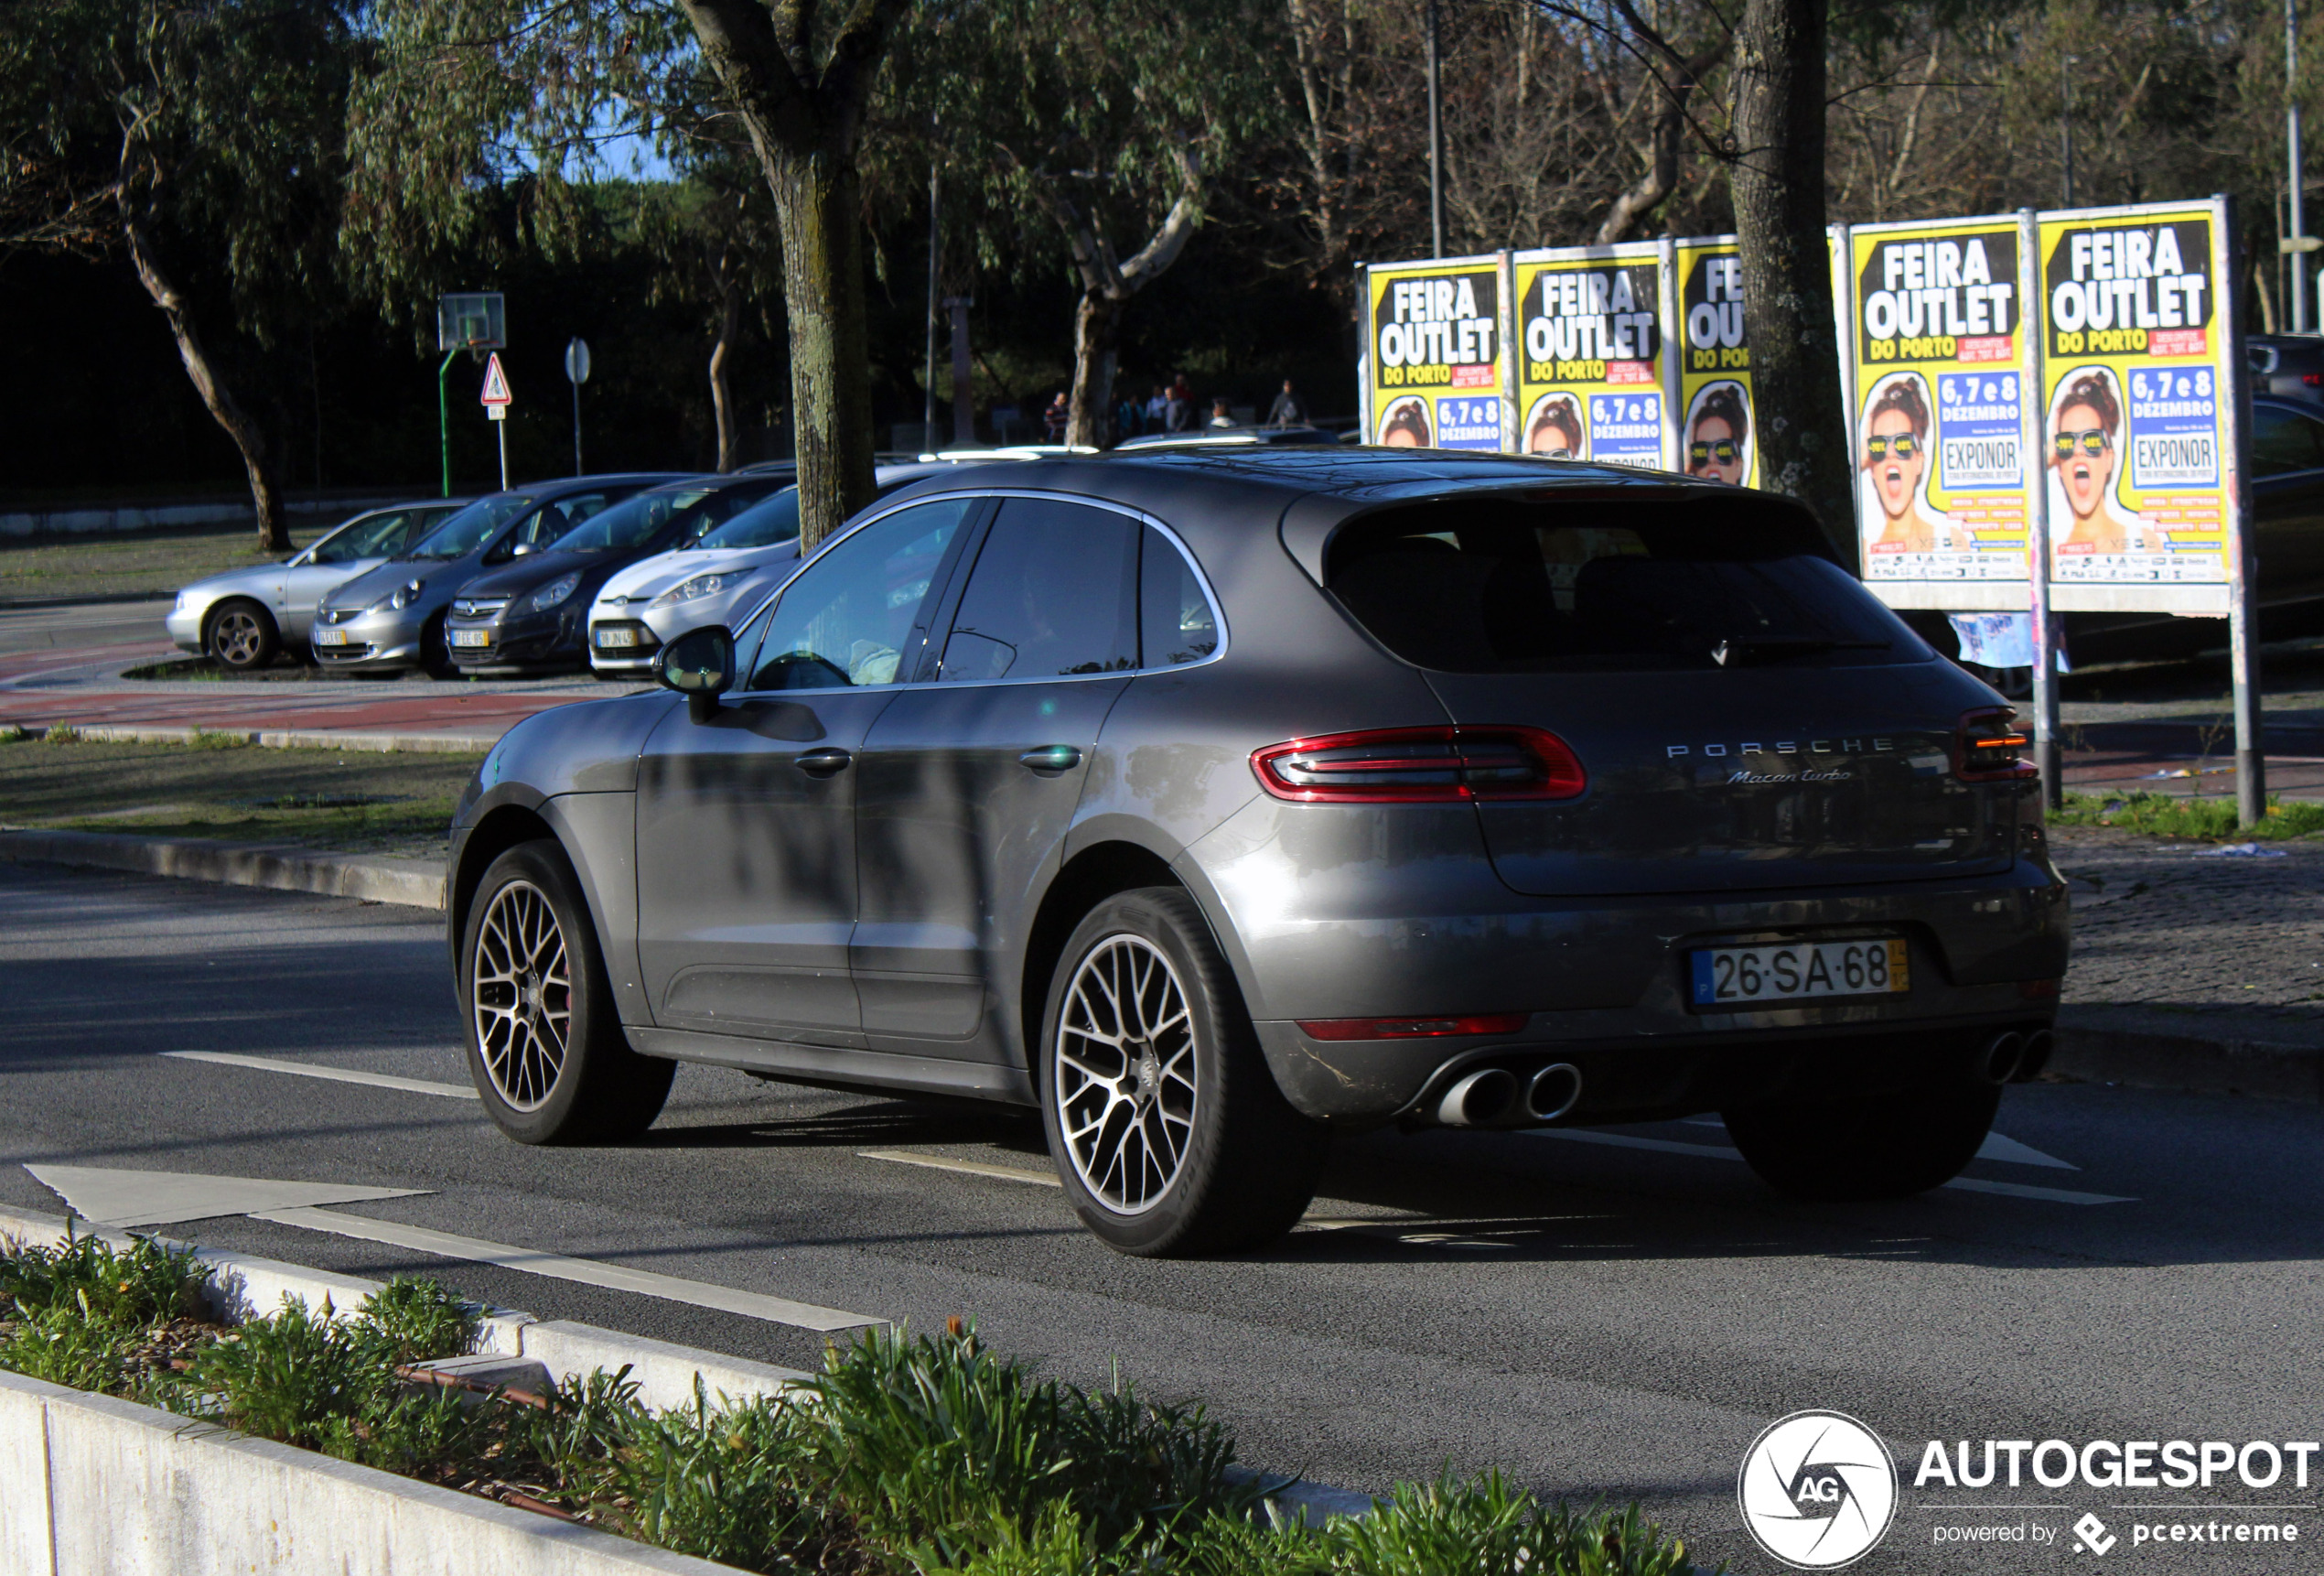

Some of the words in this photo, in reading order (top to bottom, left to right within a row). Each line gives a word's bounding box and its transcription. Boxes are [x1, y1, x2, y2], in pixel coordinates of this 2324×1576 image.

[1884, 238, 1991, 291] FEIRA
[2071, 227, 2184, 282] FEIRA
[1393, 277, 1478, 324] FEIRA
[1542, 270, 1635, 318] FEIRA
[2052, 274, 2206, 333] OUTLET
[1865, 283, 2012, 340] OUTLET
[1380, 317, 1493, 367] OUTLET
[1526, 311, 1654, 362] OUTLET
[1870, 339, 1896, 360] DO
[1899, 336, 1957, 358] PORTO
[2057, 331, 2084, 354] DO
[2088, 329, 2147, 351] PORTO
[1530, 362, 1554, 381] DO
[1556, 360, 1606, 380] PORTO
[1694, 350, 1716, 369] DO
[1383, 366, 1404, 385] DO
[1406, 364, 1451, 384] PORTO
[2195, 371, 2211, 397] 8
[2001, 376, 2017, 401] 8
[1485, 401, 1498, 423] 8
[1644, 397, 1658, 421] 8
[1942, 405, 2018, 422] DEZEMBRO
[2133, 401, 2213, 418] DEZEMBRO
[1439, 426, 1500, 441] DEZEMBRO
[1593, 425, 1660, 439] DEZEMBRO
[1947, 442, 2017, 470] EXPONOR
[2137, 439, 2211, 468] EXPONOR
[1667, 739, 1894, 759] PORSCHE
[1727, 771, 1796, 785] Macan
